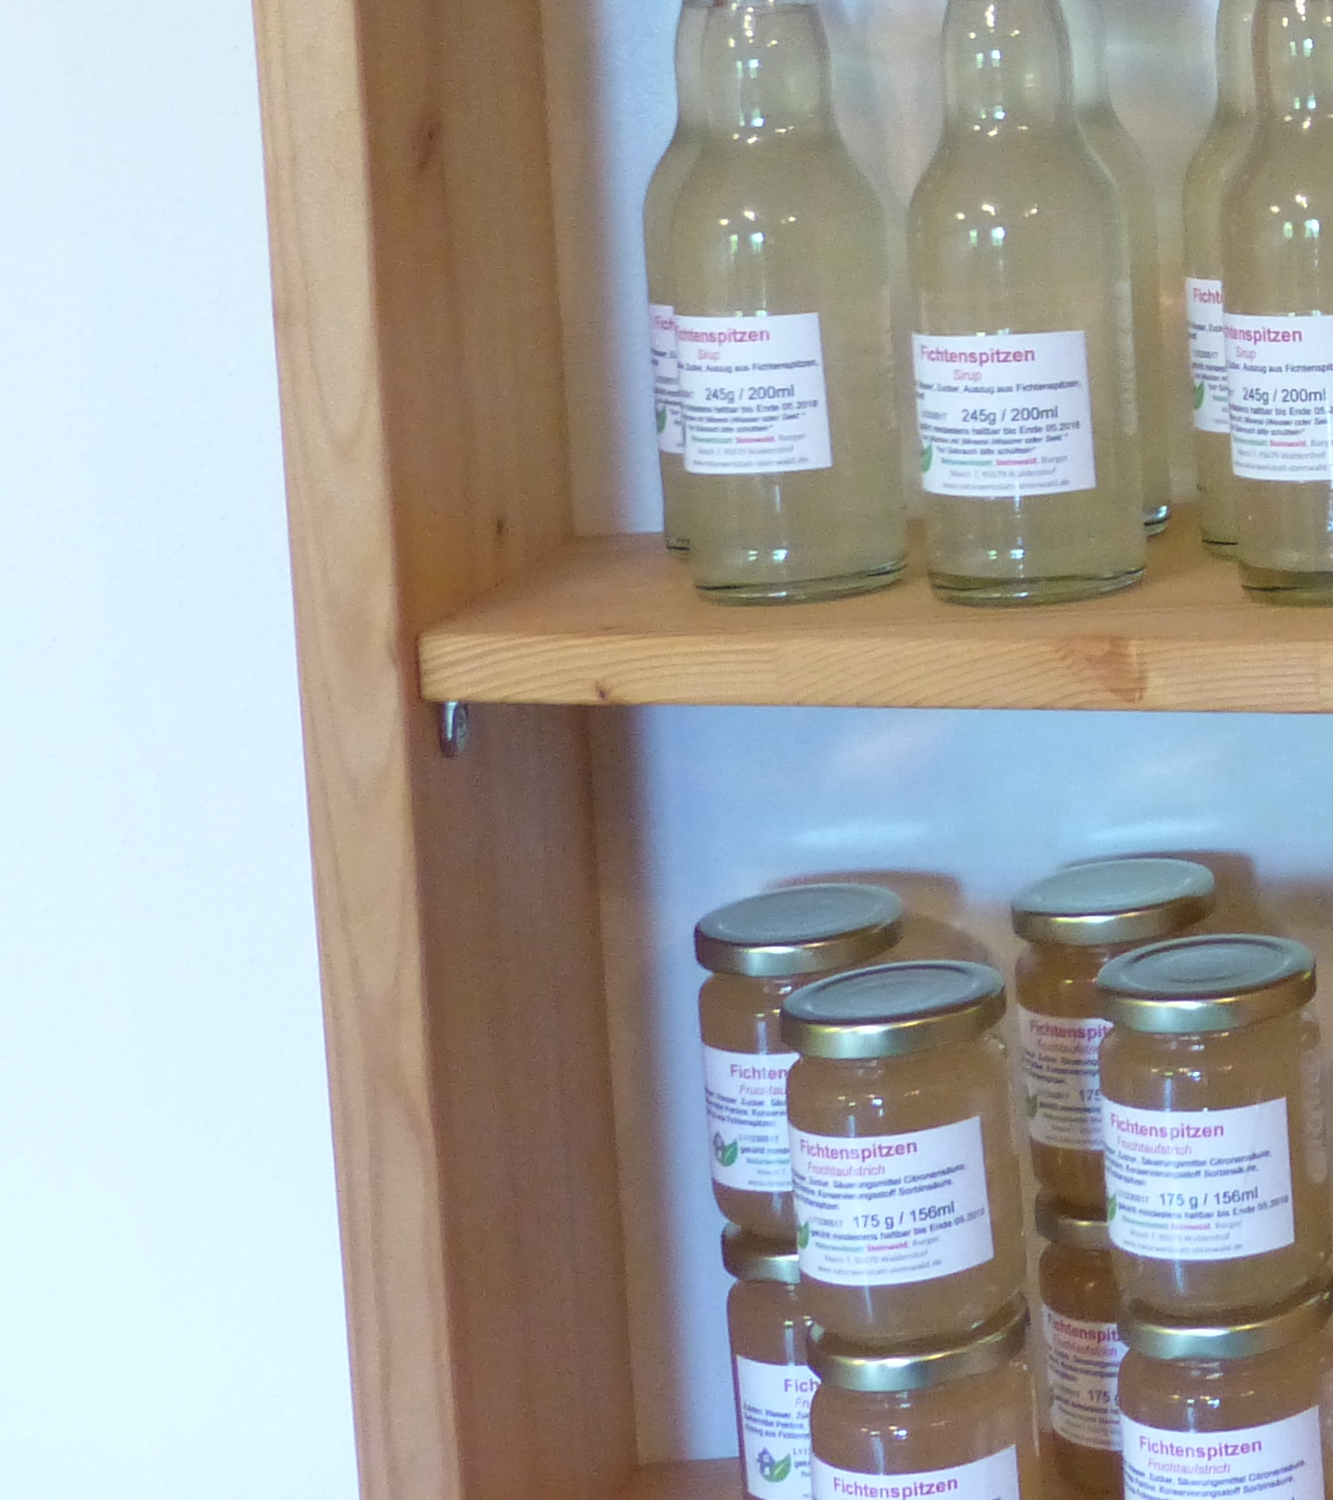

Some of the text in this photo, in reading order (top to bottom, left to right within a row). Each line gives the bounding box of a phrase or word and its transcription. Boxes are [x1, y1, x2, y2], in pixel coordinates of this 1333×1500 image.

[921, 345, 1035, 366] Fichtenspitzen
[953, 369, 982, 383] Sirup
[705, 385, 795, 403] 245g 200ml
[1243, 388, 1326, 405] 245g 200ml
[961, 405, 1058, 425] 245g 200ml
[1111, 1114, 1224, 1139] Fichtenspitzen
[800, 1139, 918, 1163] Fichtenspitzen
[1159, 1187, 1258, 1209] 175 g 156ml
[853, 1201, 955, 1230] 175 g 156ml
[1140, 1435, 1262, 1460] Fichtenspitzen
[834, 1477, 958, 1499] Fichtenspitzen
